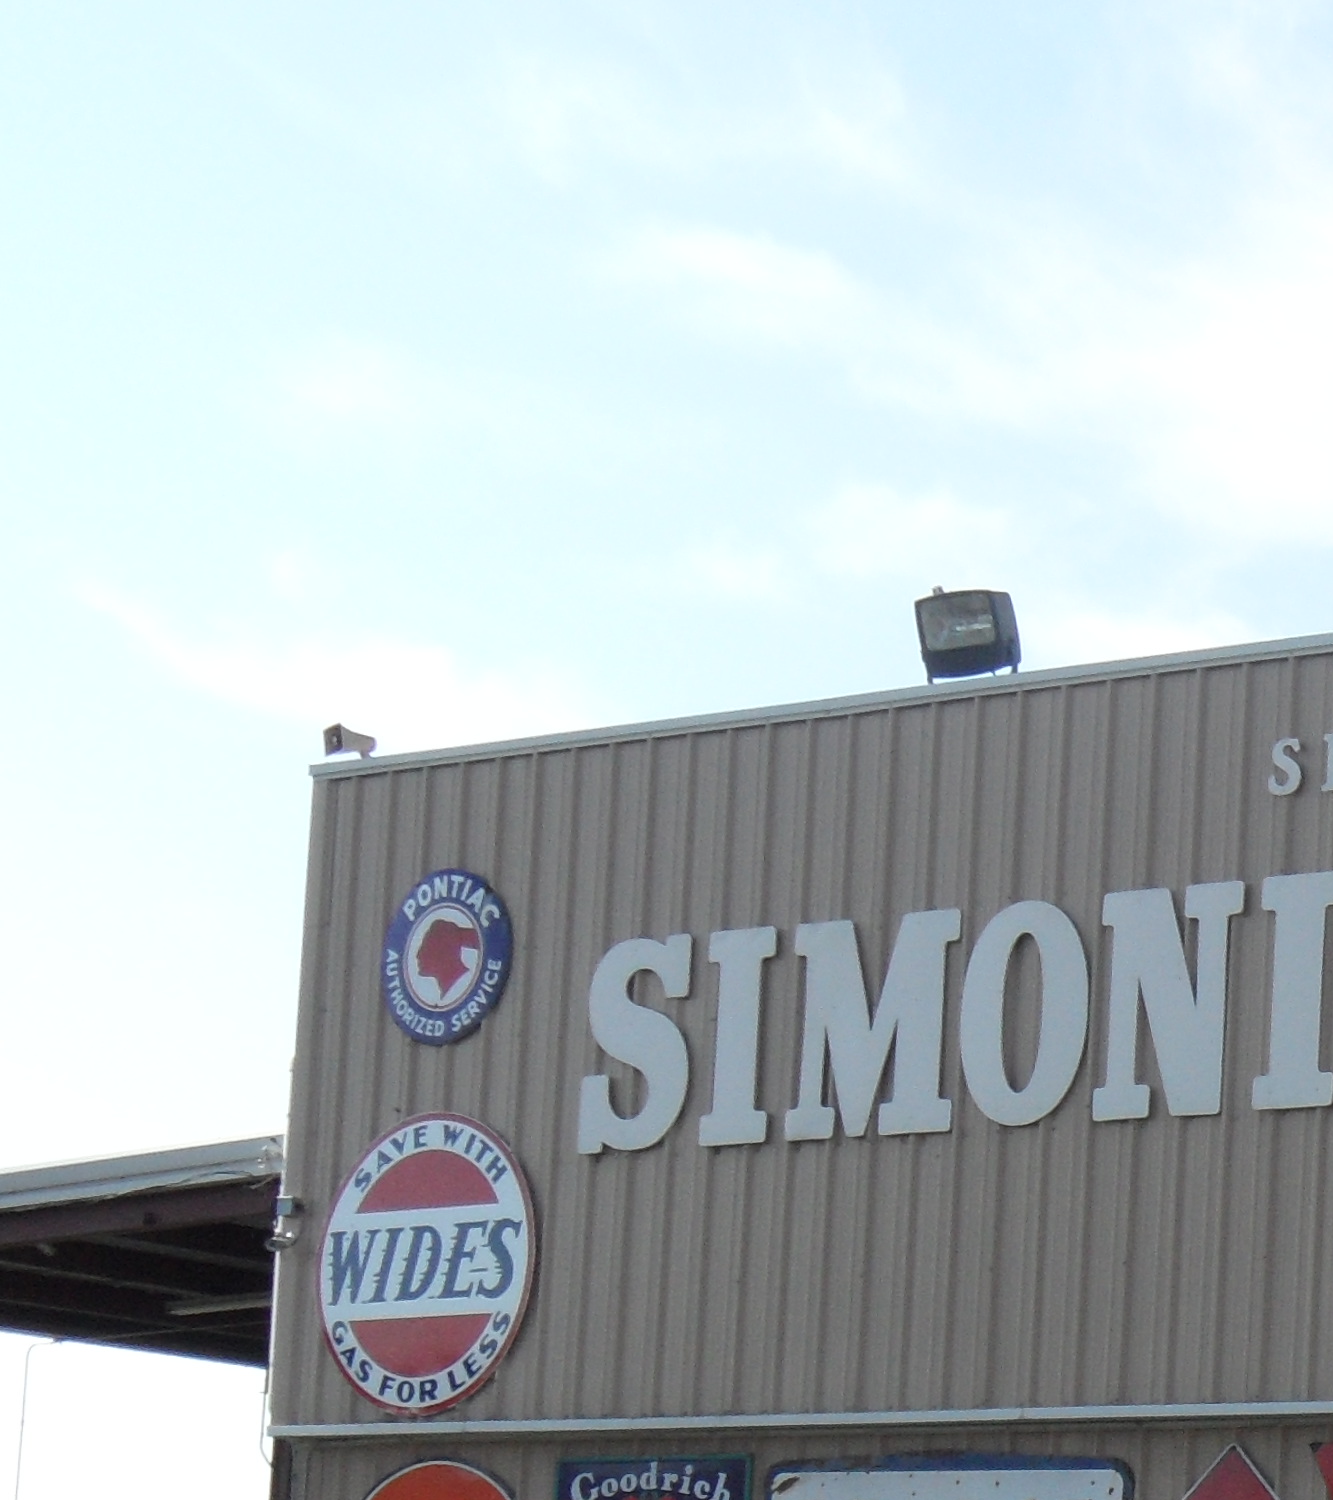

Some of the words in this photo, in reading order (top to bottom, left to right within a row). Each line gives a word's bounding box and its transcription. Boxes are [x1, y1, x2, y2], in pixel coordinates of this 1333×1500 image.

[402, 874, 502, 928] PONTIAC
[385, 948, 446, 1037] AUTHORIZED
[450, 958, 502, 1033] SERVICE
[354, 1124, 429, 1193] SAVE
[442, 1123, 509, 1185] WITH
[327, 1217, 524, 1308] WIDES
[331, 1320, 373, 1384] GAS
[378, 1374, 439, 1403] FOR
[447, 1310, 511, 1393] LESS
